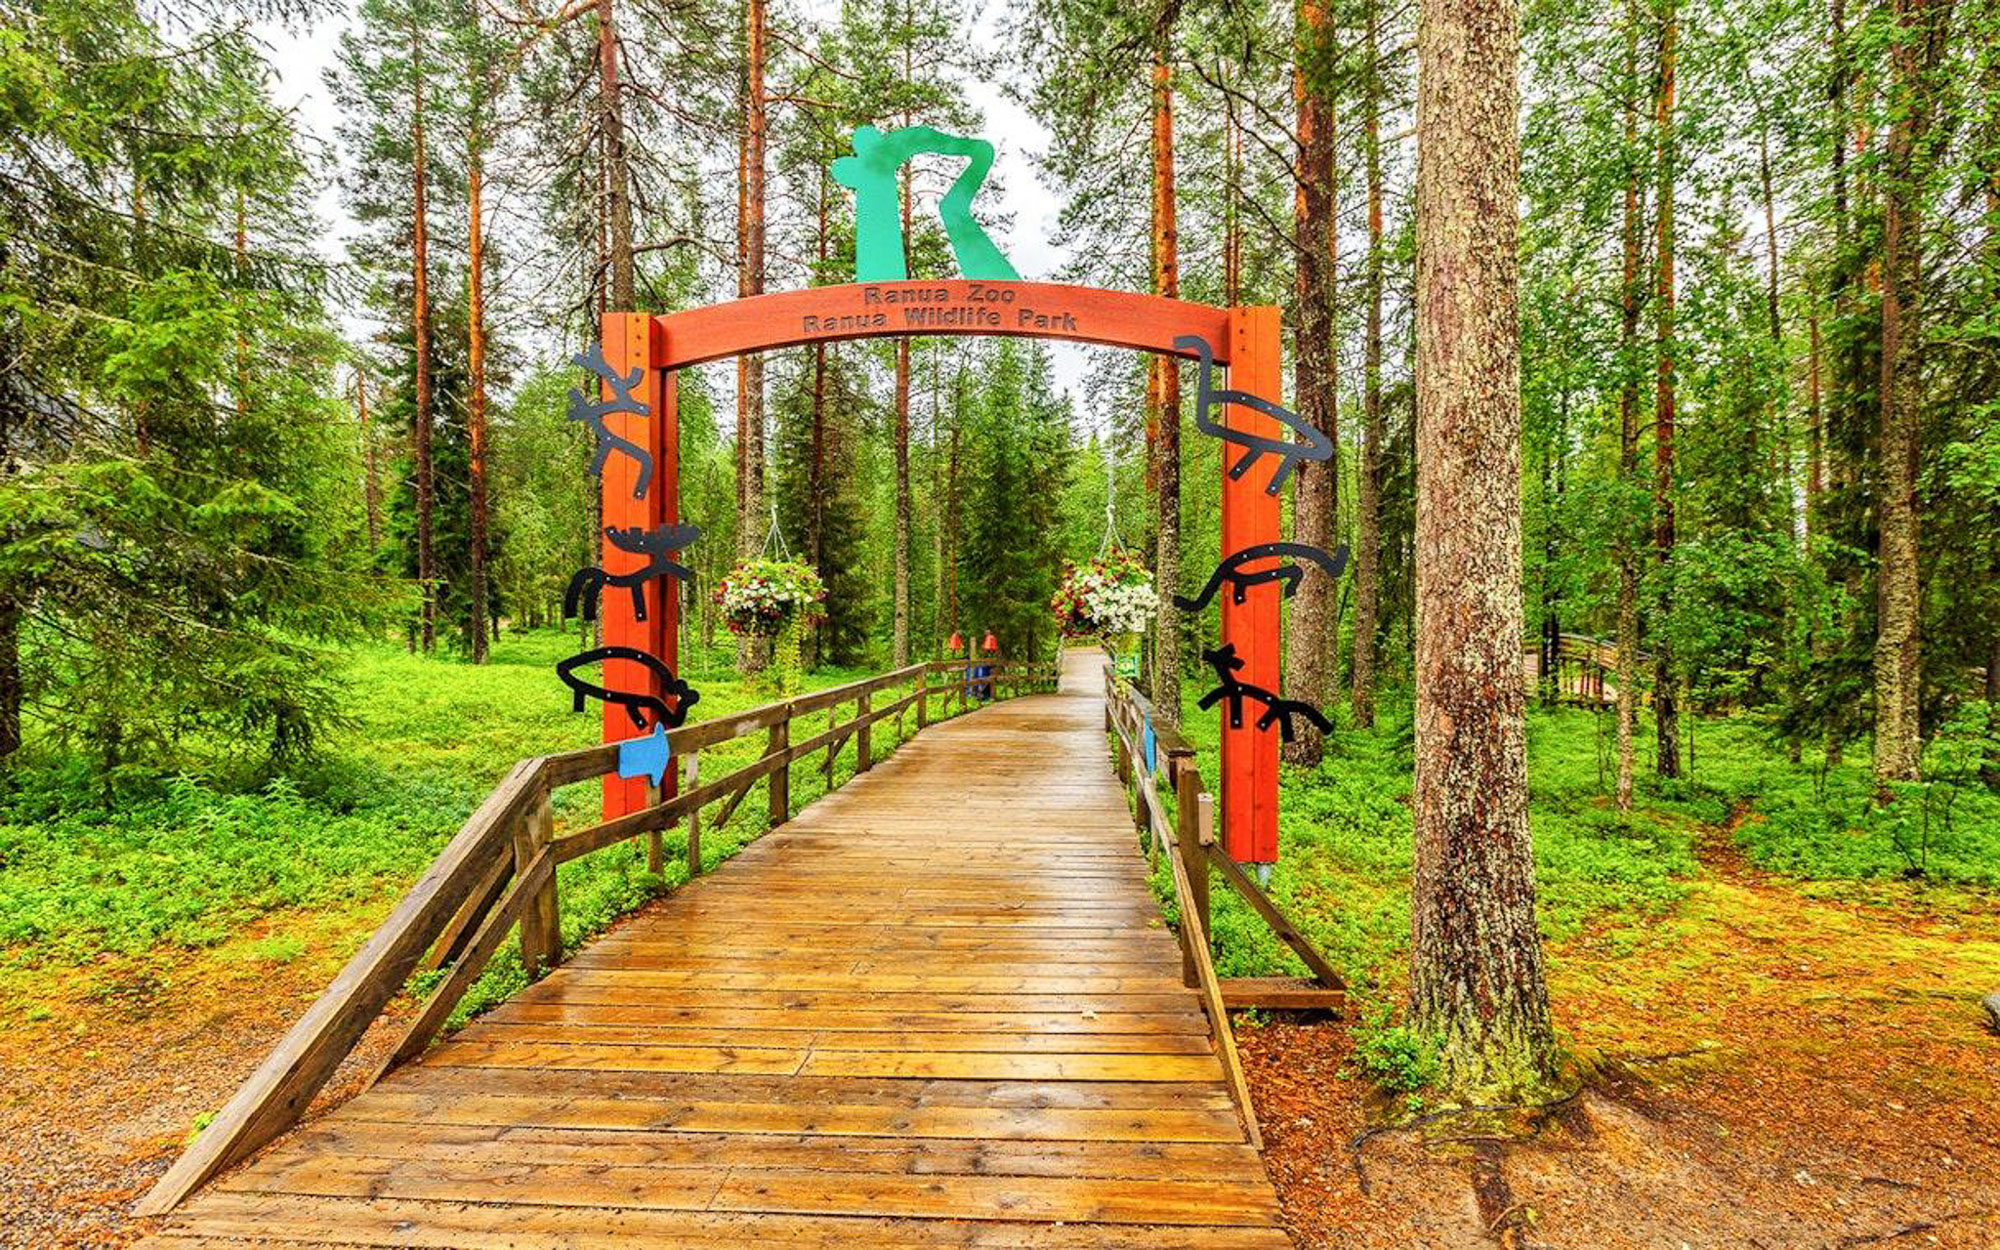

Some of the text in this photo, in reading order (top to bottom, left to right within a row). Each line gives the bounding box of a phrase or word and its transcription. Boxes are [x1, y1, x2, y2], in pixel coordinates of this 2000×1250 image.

[864, 284, 1016, 305] Ranua Zoo
[803, 306, 1078, 333] Ranua Wildlife Park
